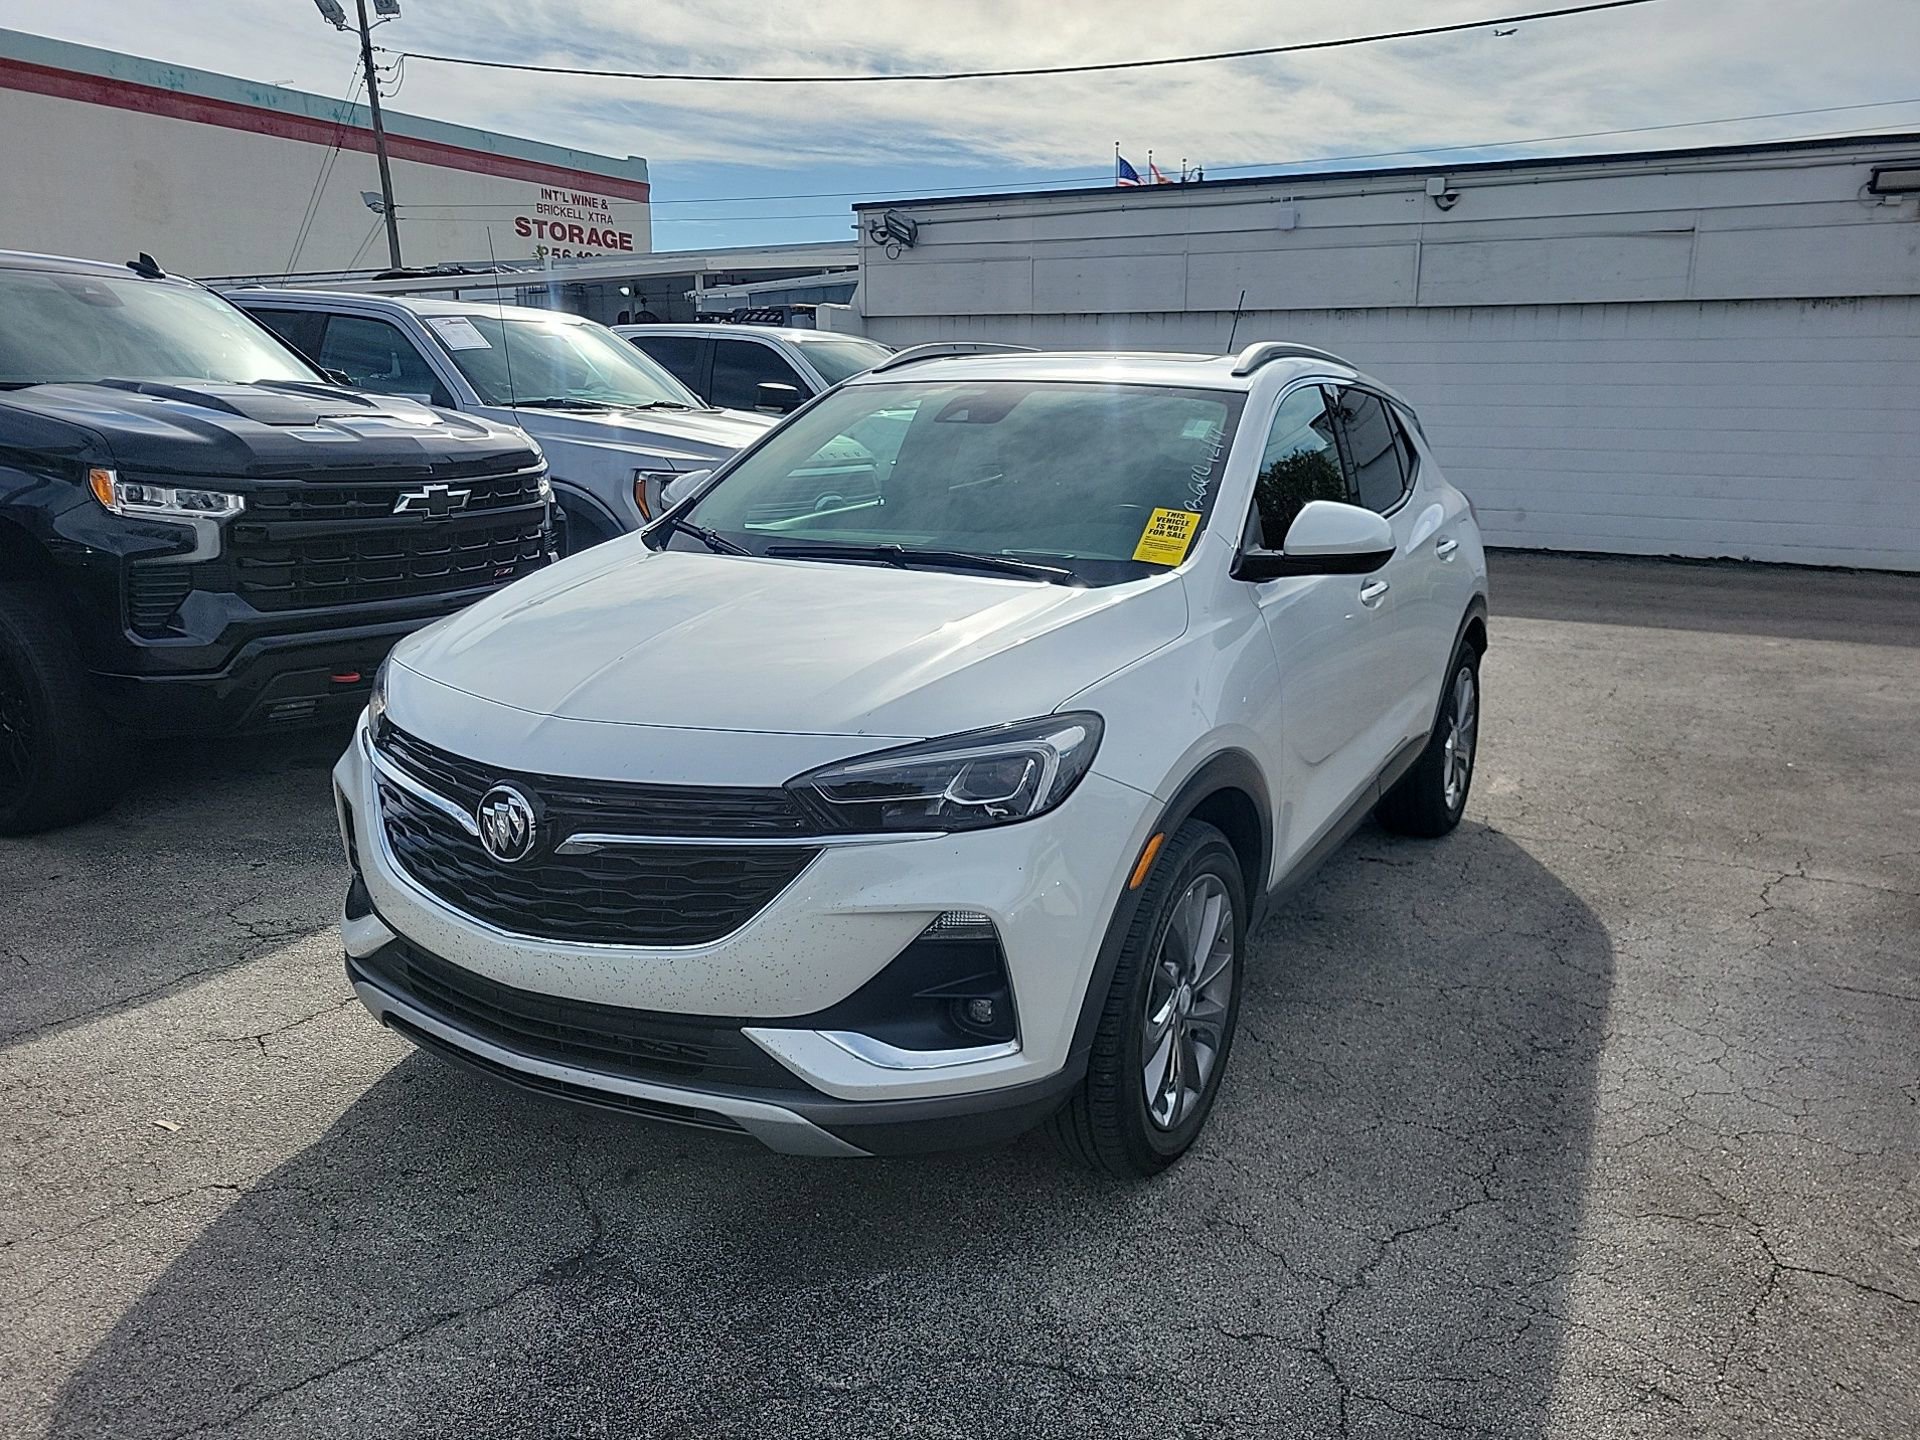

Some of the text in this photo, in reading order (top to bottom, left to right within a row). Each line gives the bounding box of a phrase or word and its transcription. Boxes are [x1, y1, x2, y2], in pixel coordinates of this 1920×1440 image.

[541, 188, 609, 210] INT'L WINE &
[536, 203, 614, 225] BRICKELL XTRA
[514, 216, 633, 252] STORAGE
[1156, 516, 1191, 527] VEHICLE
[1166, 511, 1186, 519] THIS
[1148, 528, 1165, 536] FOR
[1166, 531, 1188, 540] SALE
